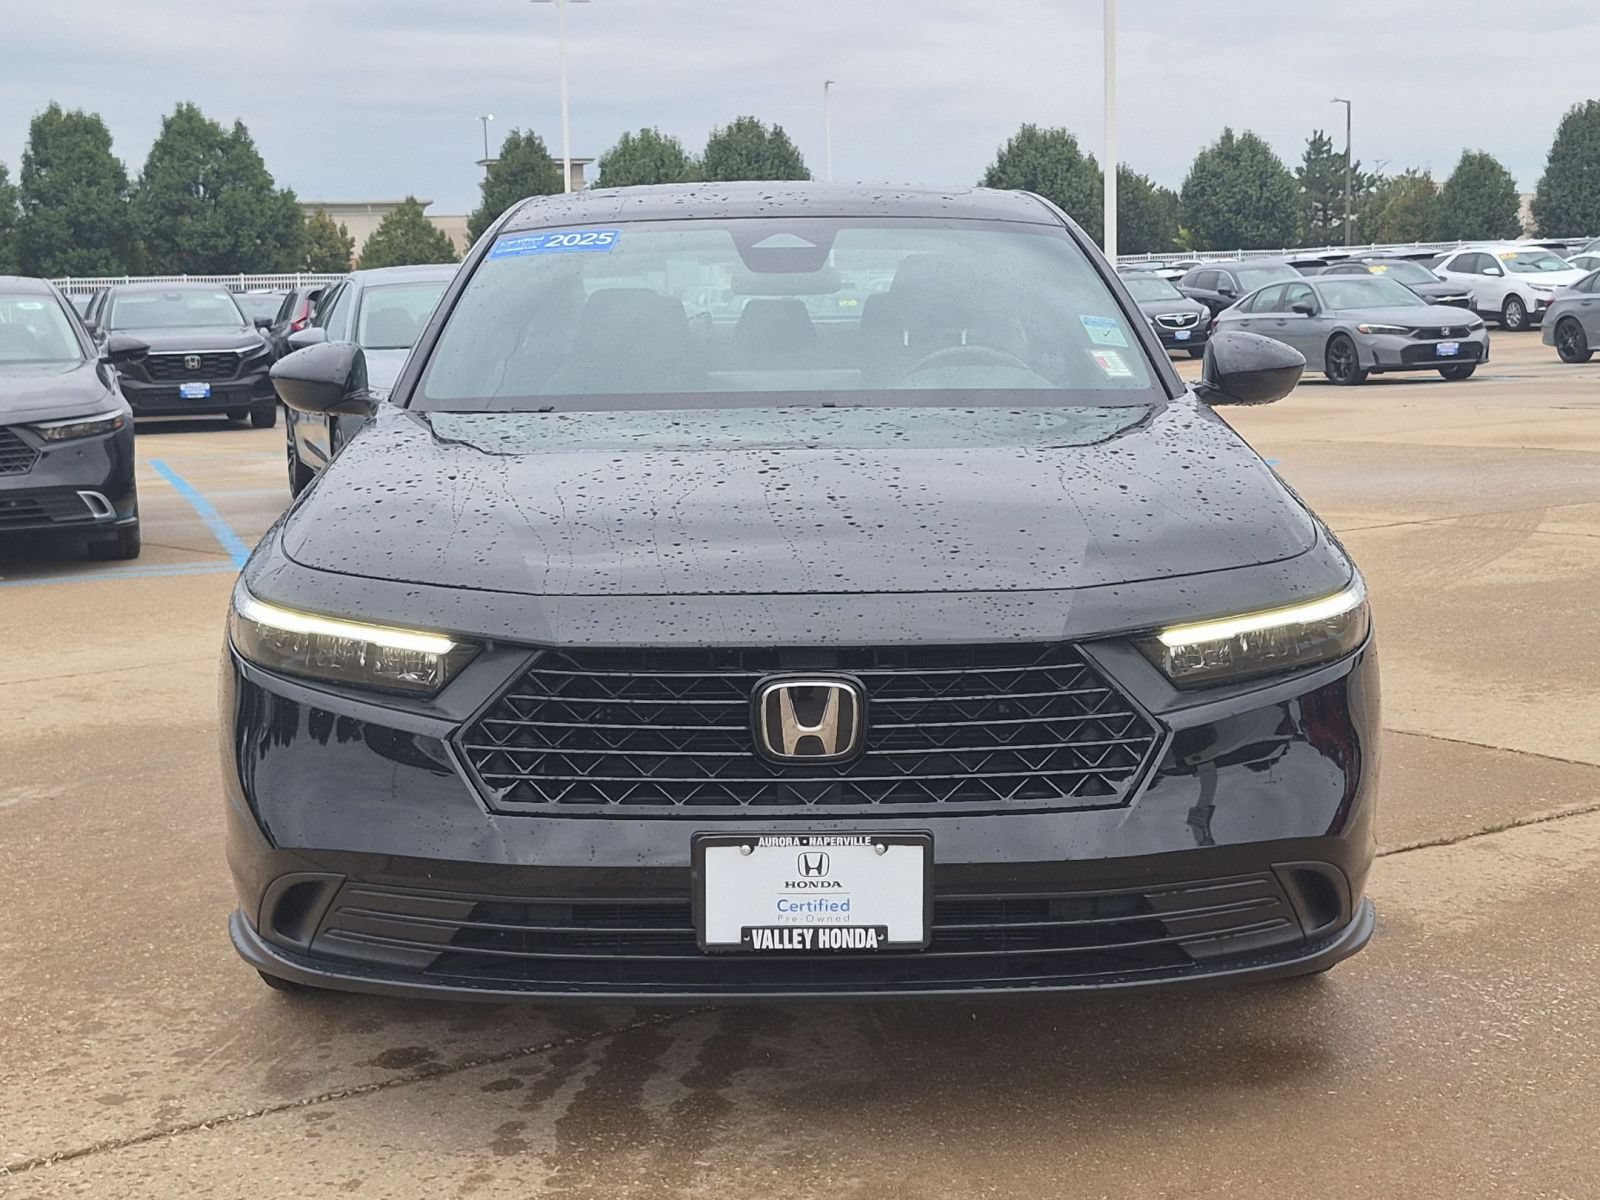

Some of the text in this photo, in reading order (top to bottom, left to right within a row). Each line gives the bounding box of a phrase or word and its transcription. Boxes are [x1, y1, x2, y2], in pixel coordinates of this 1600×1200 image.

[544, 232, 614, 248] 2025
[758, 836, 871, 847] AURORA NAPERVILLE
[777, 898, 850, 912] Certified
[777, 914, 850, 922] Pre-Owned
[752, 928, 878, 949] VALLEY HONDA
